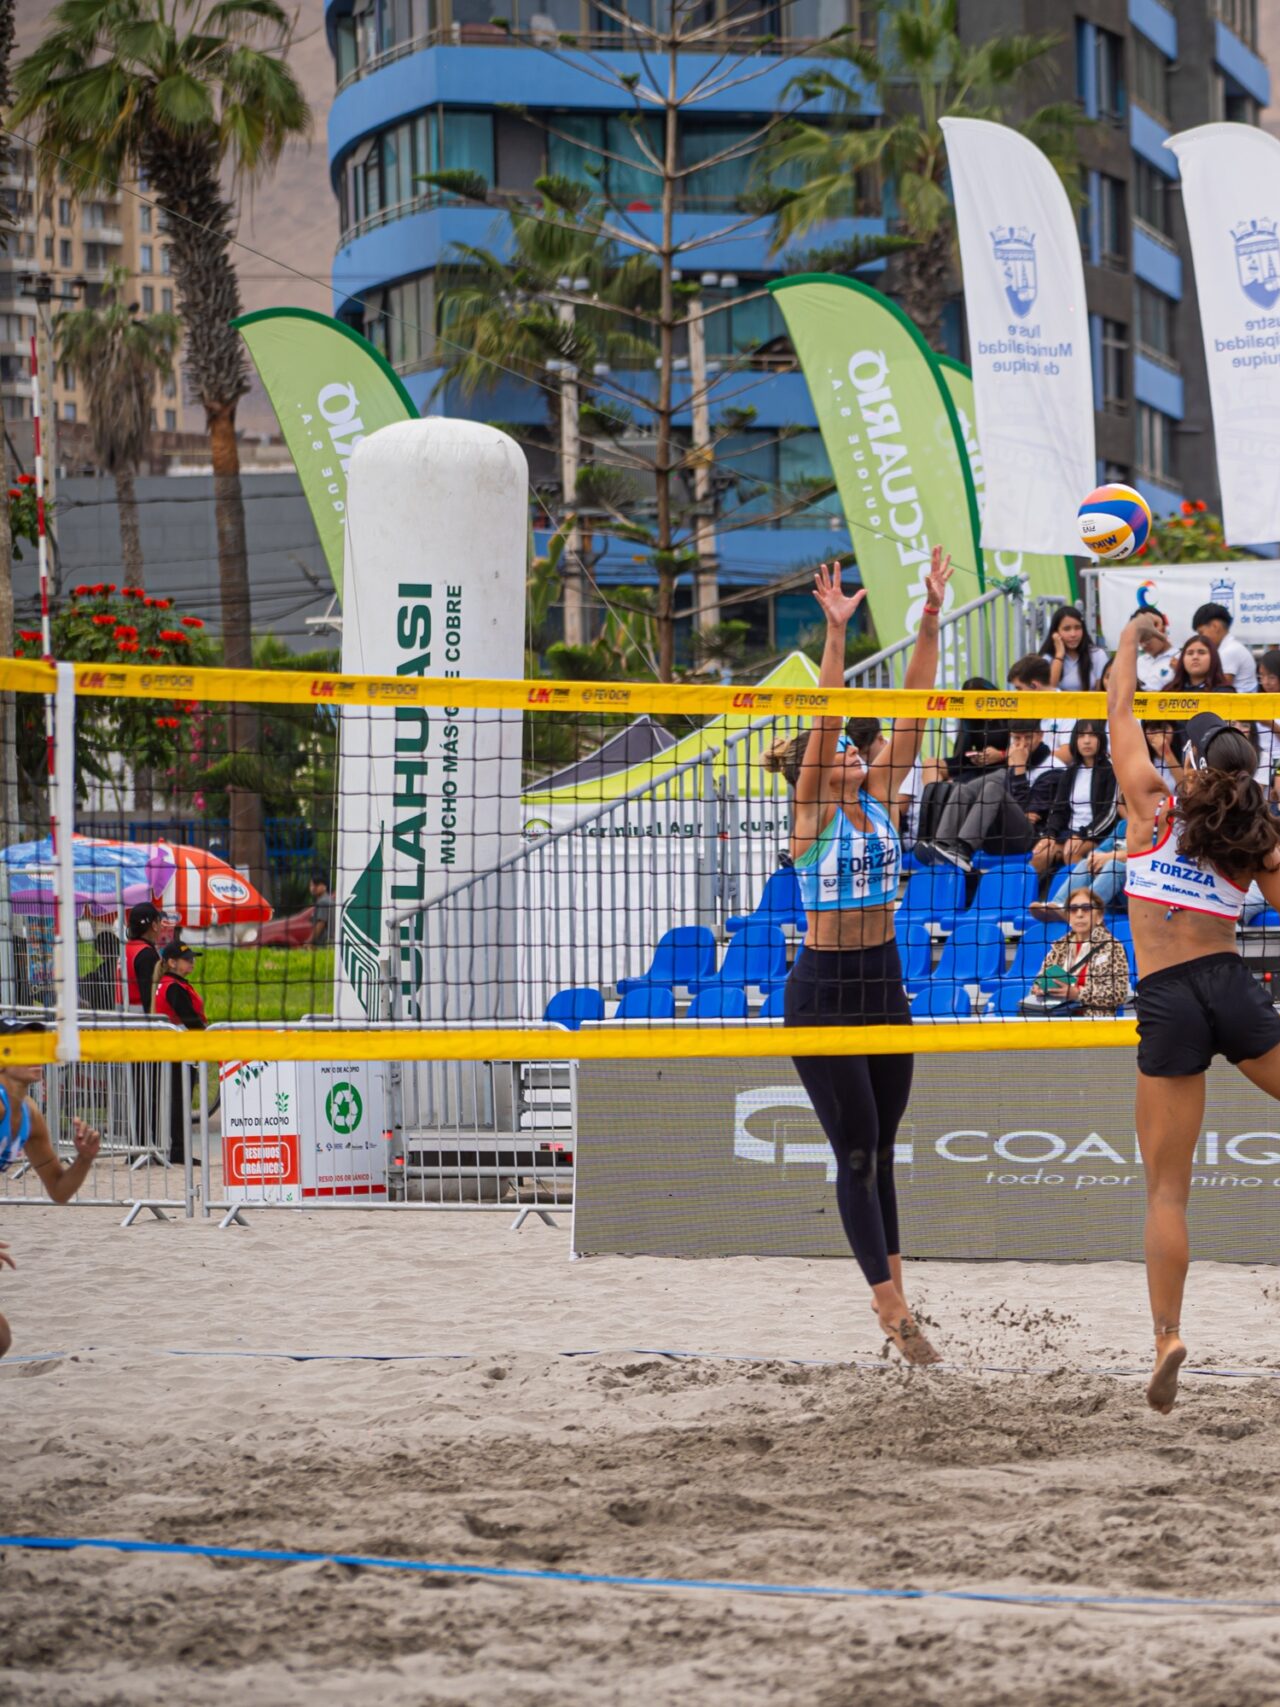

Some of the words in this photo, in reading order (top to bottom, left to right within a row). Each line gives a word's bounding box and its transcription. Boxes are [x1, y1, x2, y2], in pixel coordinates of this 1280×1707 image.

[445, 584, 463, 662] COBRE
[1240, 616, 1251, 624] de
[79, 672, 107, 689] UK
[310, 680, 338, 698] UK
[527, 687, 553, 704] UK
[732, 692, 755, 709] UK
[926, 696, 948, 712] UK
[441, 722, 461, 774] MÁS
[387, 583, 433, 1021] OLLAHUASI
[440, 776, 459, 865] MUCHO
[1150, 859, 1216, 888] FORZZA
[986, 1168, 1064, 1186] todo
[1075, 1172, 1137, 1190] por
[1190, 1171, 1262, 1188] niño
